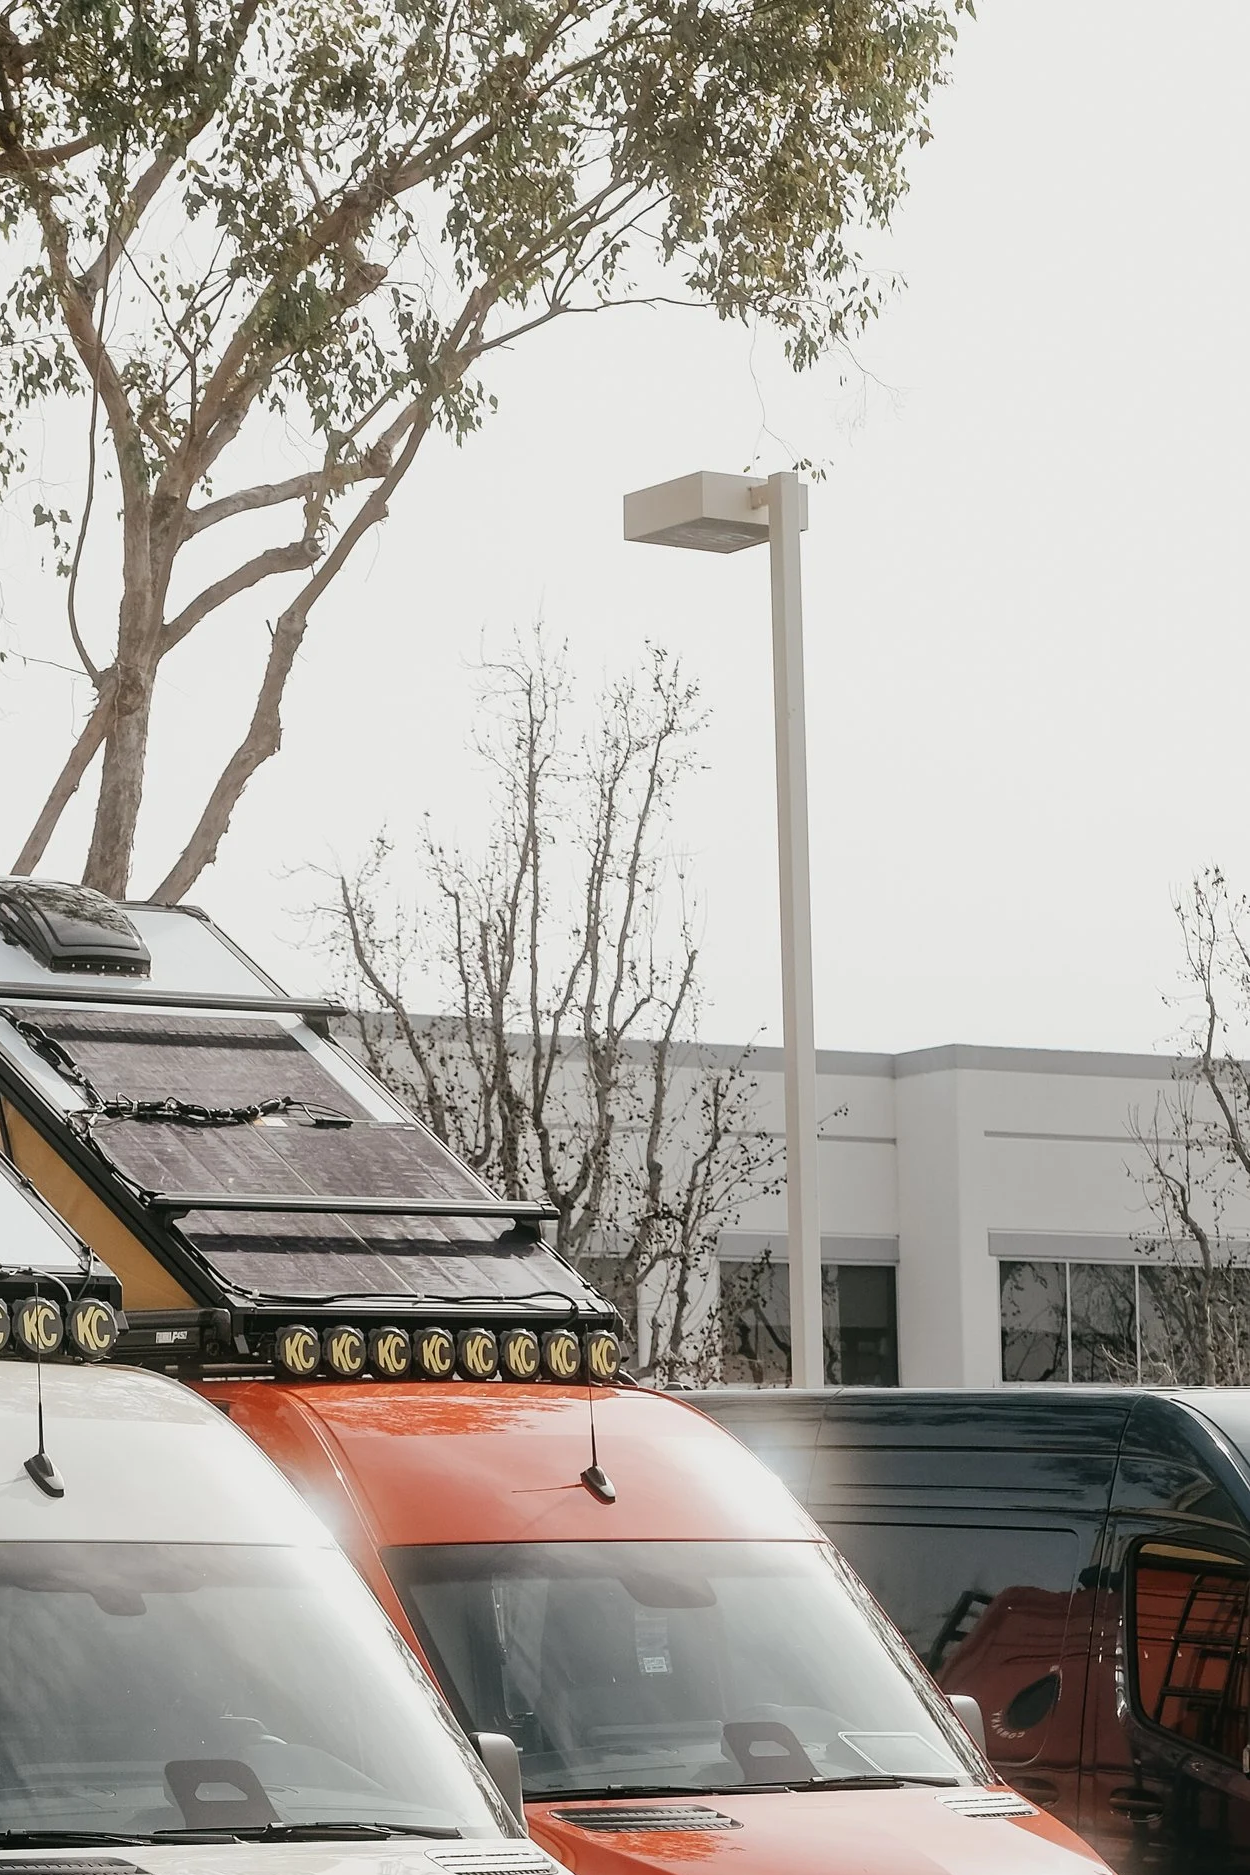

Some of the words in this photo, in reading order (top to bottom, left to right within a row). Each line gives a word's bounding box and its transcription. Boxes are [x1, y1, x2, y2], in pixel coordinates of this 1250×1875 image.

[23, 1306, 57, 1348] KC
[76, 1306, 111, 1350] KC
[284, 1332, 315, 1373] KC
[331, 1332, 362, 1373] KC
[377, 1334, 407, 1374] KC
[422, 1334, 451, 1375] KC
[466, 1335, 494, 1375] KC
[508, 1335, 536, 1376] KC
[550, 1337, 577, 1377] KC
[591, 1337, 617, 1377] KC
